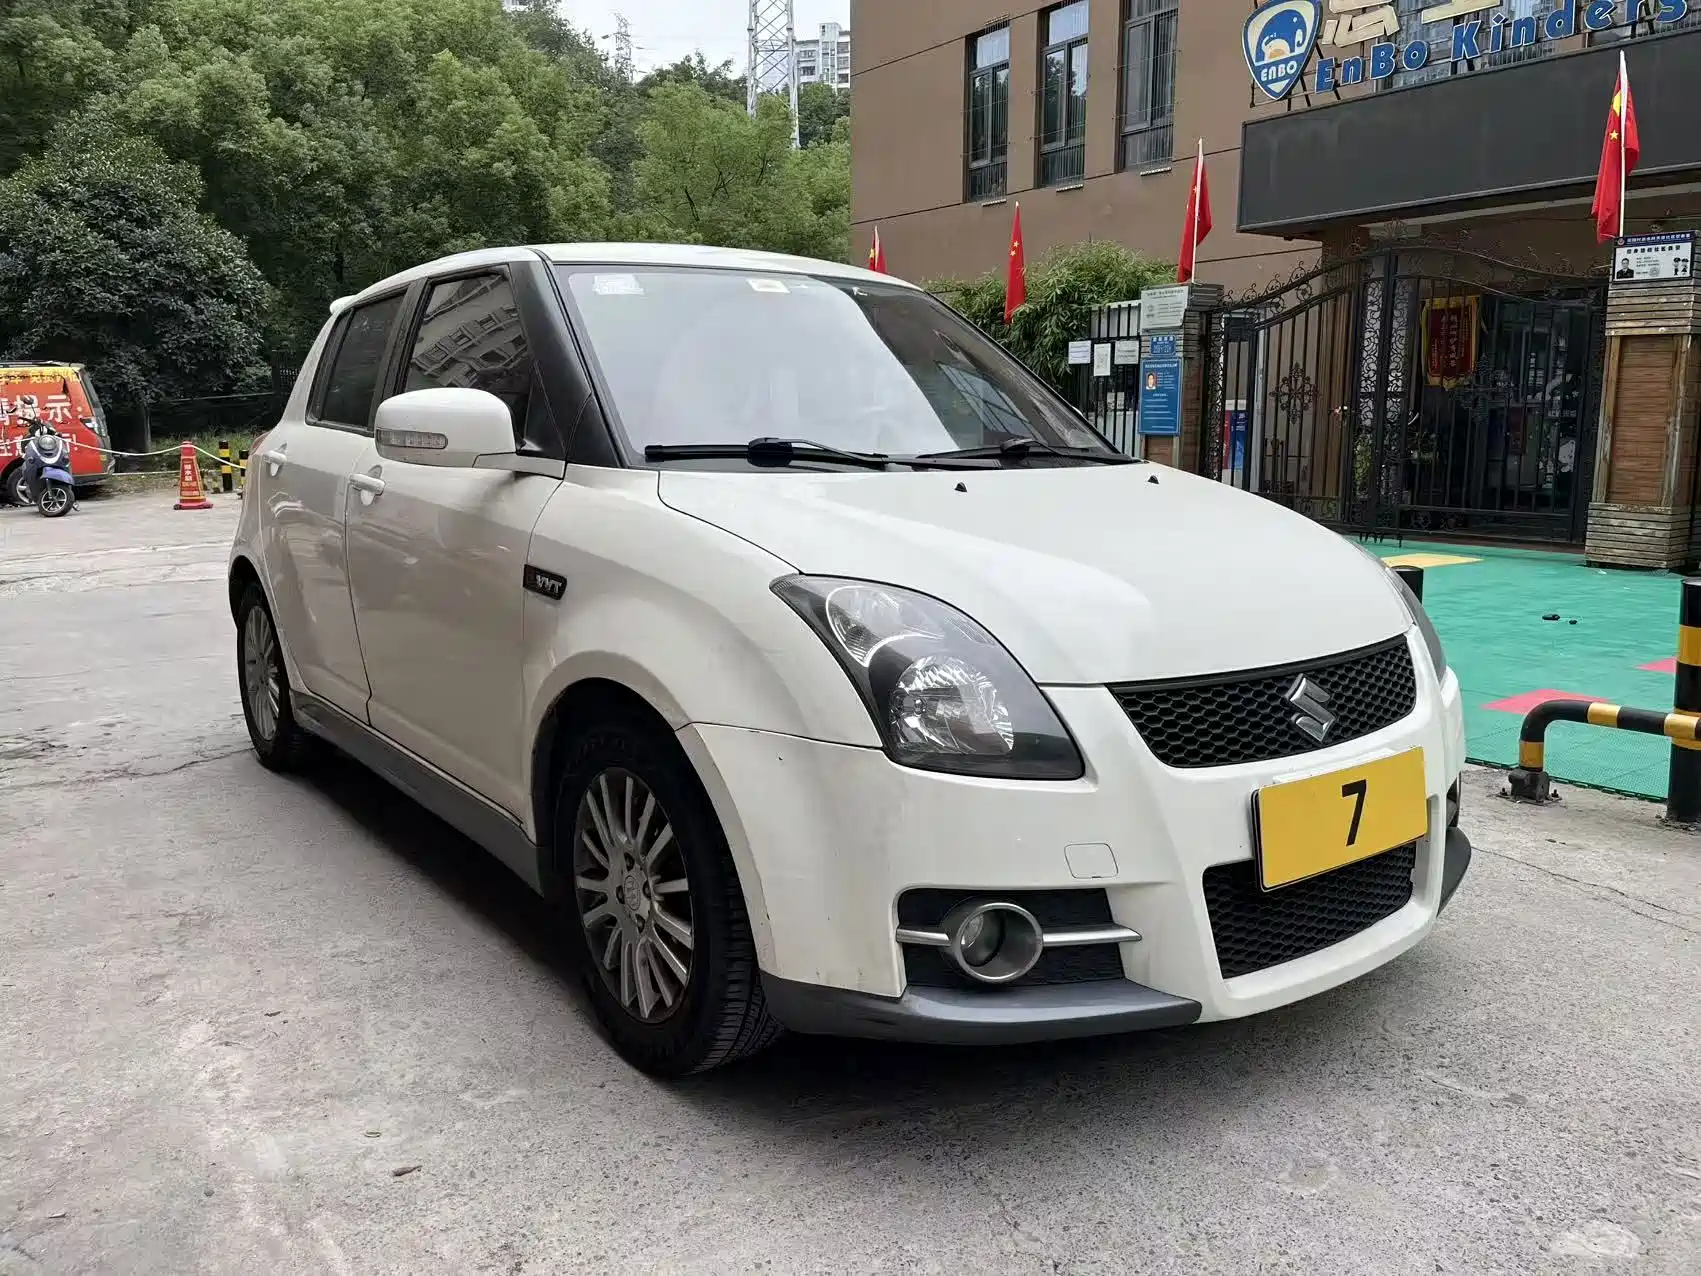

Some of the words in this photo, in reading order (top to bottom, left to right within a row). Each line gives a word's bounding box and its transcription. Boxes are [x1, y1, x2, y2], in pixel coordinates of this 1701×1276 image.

[1260, 61, 1298, 82] ENBO
[1315, 40, 1429, 93] EnBo
[1451, 0, 1688, 62] Kinders
[1341, 778, 1367, 847] 7
